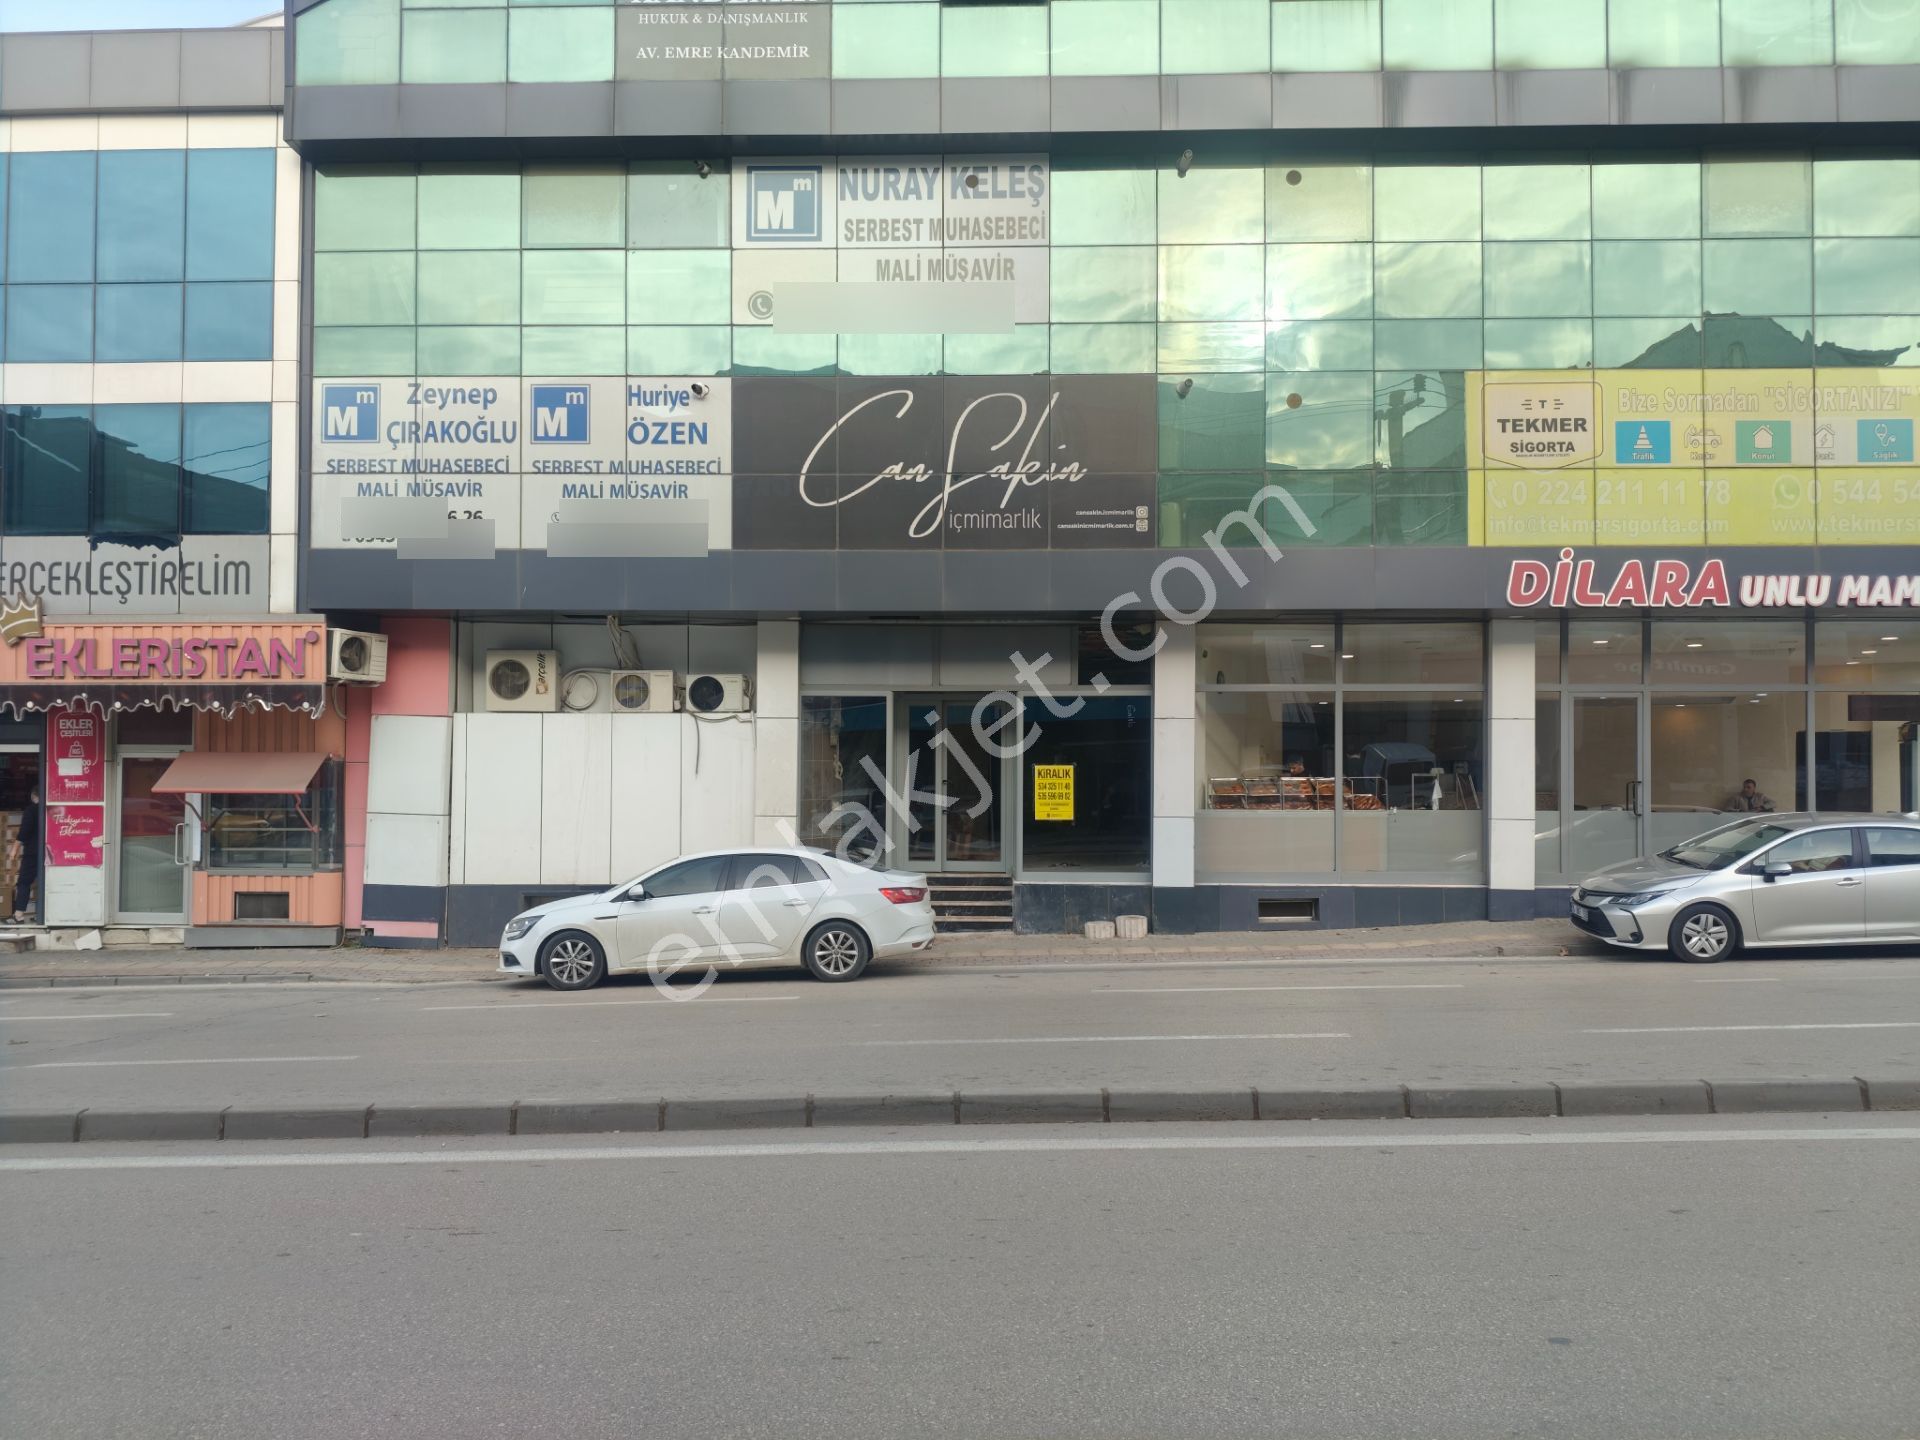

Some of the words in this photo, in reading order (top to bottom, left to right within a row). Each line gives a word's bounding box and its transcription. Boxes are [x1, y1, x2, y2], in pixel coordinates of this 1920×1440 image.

[638, 13, 689, 24] HUKUK
[692, 13, 703, 24] &
[707, 12, 809, 26] DANIŞMANLIK
[636, 47, 660, 59] AV.
[665, 46, 713, 59] EMRE
[717, 43, 810, 59] KANDEMİR
[839, 166, 941, 202] NURAY
[950, 164, 1045, 208] KELEŞ
[844, 218, 924, 243] SERBEST
[929, 210, 1047, 242] MUHASEBECİ
[876, 253, 922, 282] MALİ
[406, 383, 498, 410] Zeynep
[627, 384, 690, 413] Huriye
[1617, 386, 1659, 413] Bize
[1663, 386, 1760, 413] Sormadan
[386, 416, 518, 450] ÇIRAKOĞLU
[627, 416, 709, 445] ÖZEN
[1496, 417, 1588, 434] TEKMER
[799, 389, 934, 507] Can
[1510, 439, 1576, 454] SİGORTA
[326, 458, 398, 474] SERBEST
[401, 455, 510, 474] MUHASEBECİ
[531, 459, 604, 475] SERBEST
[609, 456, 722, 475] MUHASEBECİ
[357, 478, 399, 498] MALİ
[562, 480, 604, 499] MALİ
[1512, 480, 1528, 505] 0
[1537, 480, 1588, 505] 224
[1597, 480, 1644, 505] 211
[1658, 480, 1687, 505] 11
[1833, 480, 1882, 505] 544
[948, 507, 1043, 533] içmimarlık
[1489, 515, 1729, 538] info@tekmersigorta.com
[1506, 547, 1731, 608] DİLARA
[1738, 575, 1832, 608] UNLU
[1836, 575, 1920, 607] MAM
[59, 718, 94, 729] EKLER
